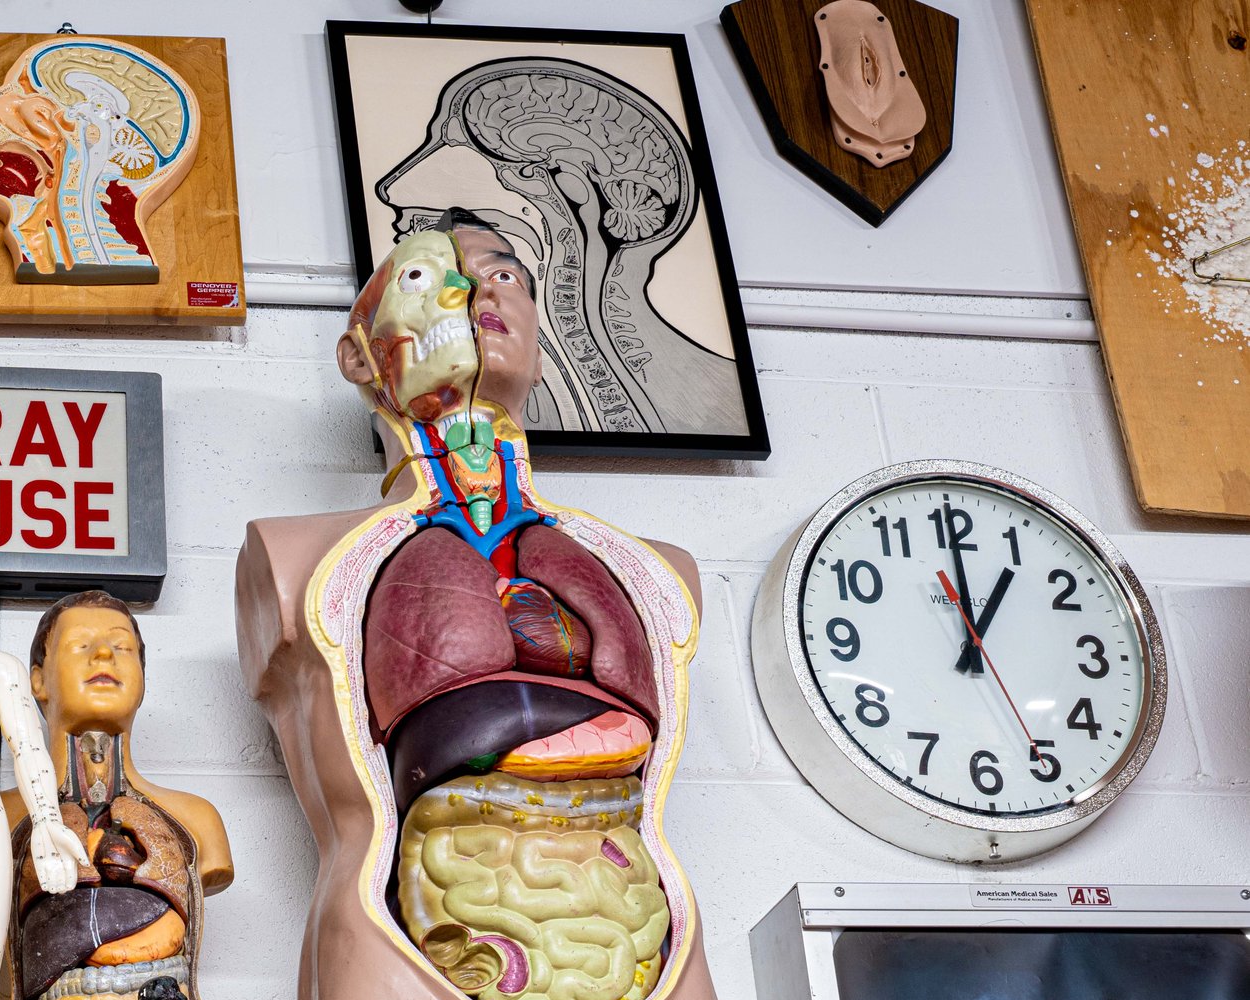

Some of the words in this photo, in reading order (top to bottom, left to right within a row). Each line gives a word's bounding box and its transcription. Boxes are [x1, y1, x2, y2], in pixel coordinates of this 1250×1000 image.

[872, 515, 911, 558] 11
[928, 507, 978, 552] 12
[1002, 525, 1022, 566] 1
[830, 558, 884, 604] 10
[1047, 568, 1082, 612] 2
[825, 617, 861, 662] 9
[1076, 634, 1110, 679] 3
[855, 683, 890, 728] 8
[1066, 697, 1103, 741] 4
[907, 731, 940, 776] 7
[969, 750, 1004, 796] 6
[1029, 739, 1062, 784] 5
[1072, 888, 1110, 904] AMS
